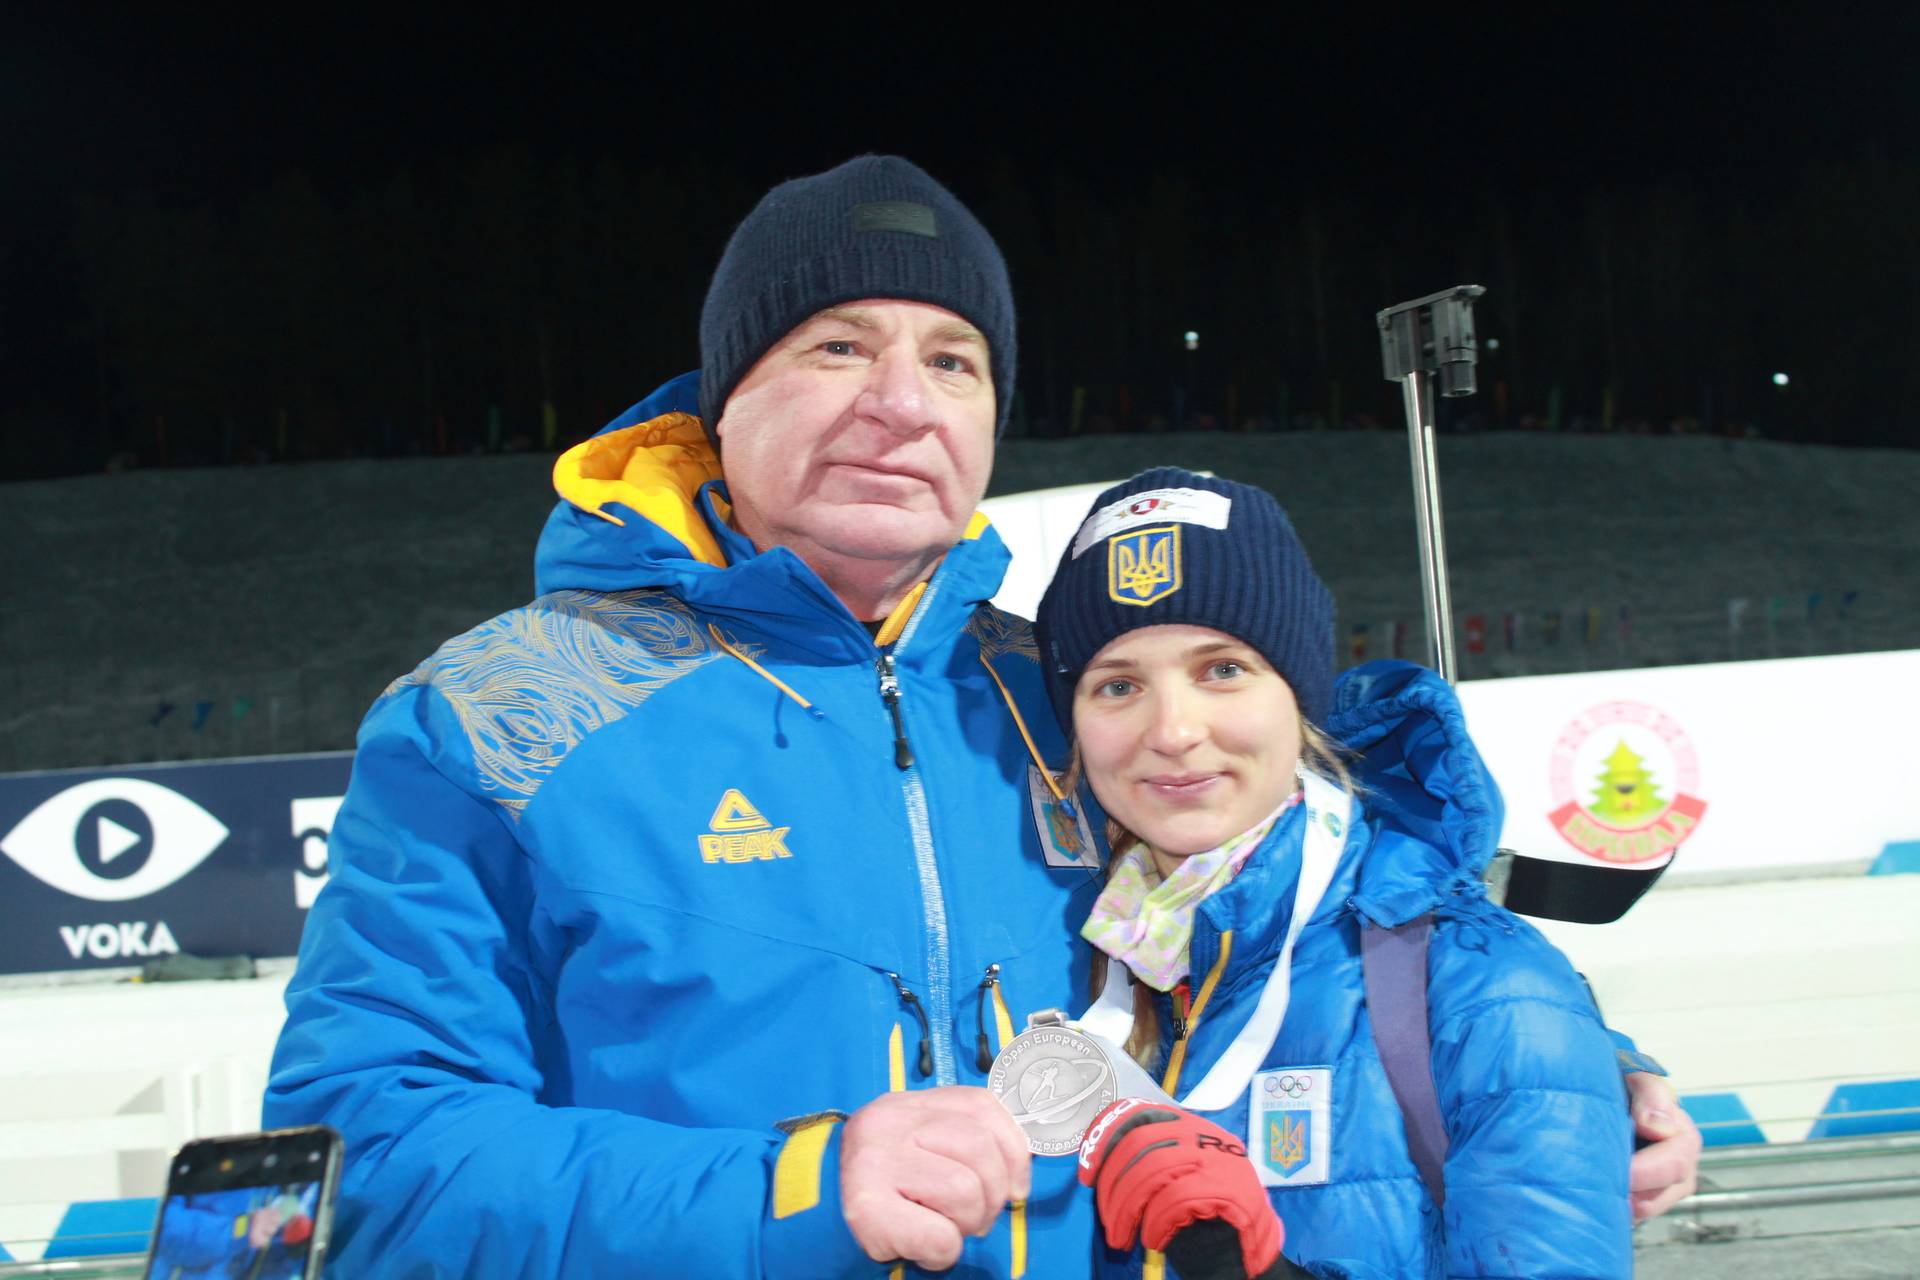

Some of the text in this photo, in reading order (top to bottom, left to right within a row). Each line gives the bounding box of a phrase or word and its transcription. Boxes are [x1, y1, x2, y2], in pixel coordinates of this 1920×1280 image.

[698, 827, 793, 863] PEAK
[59, 921, 180, 958] VOKA
[993, 1033, 1090, 1093] IBU Open European
